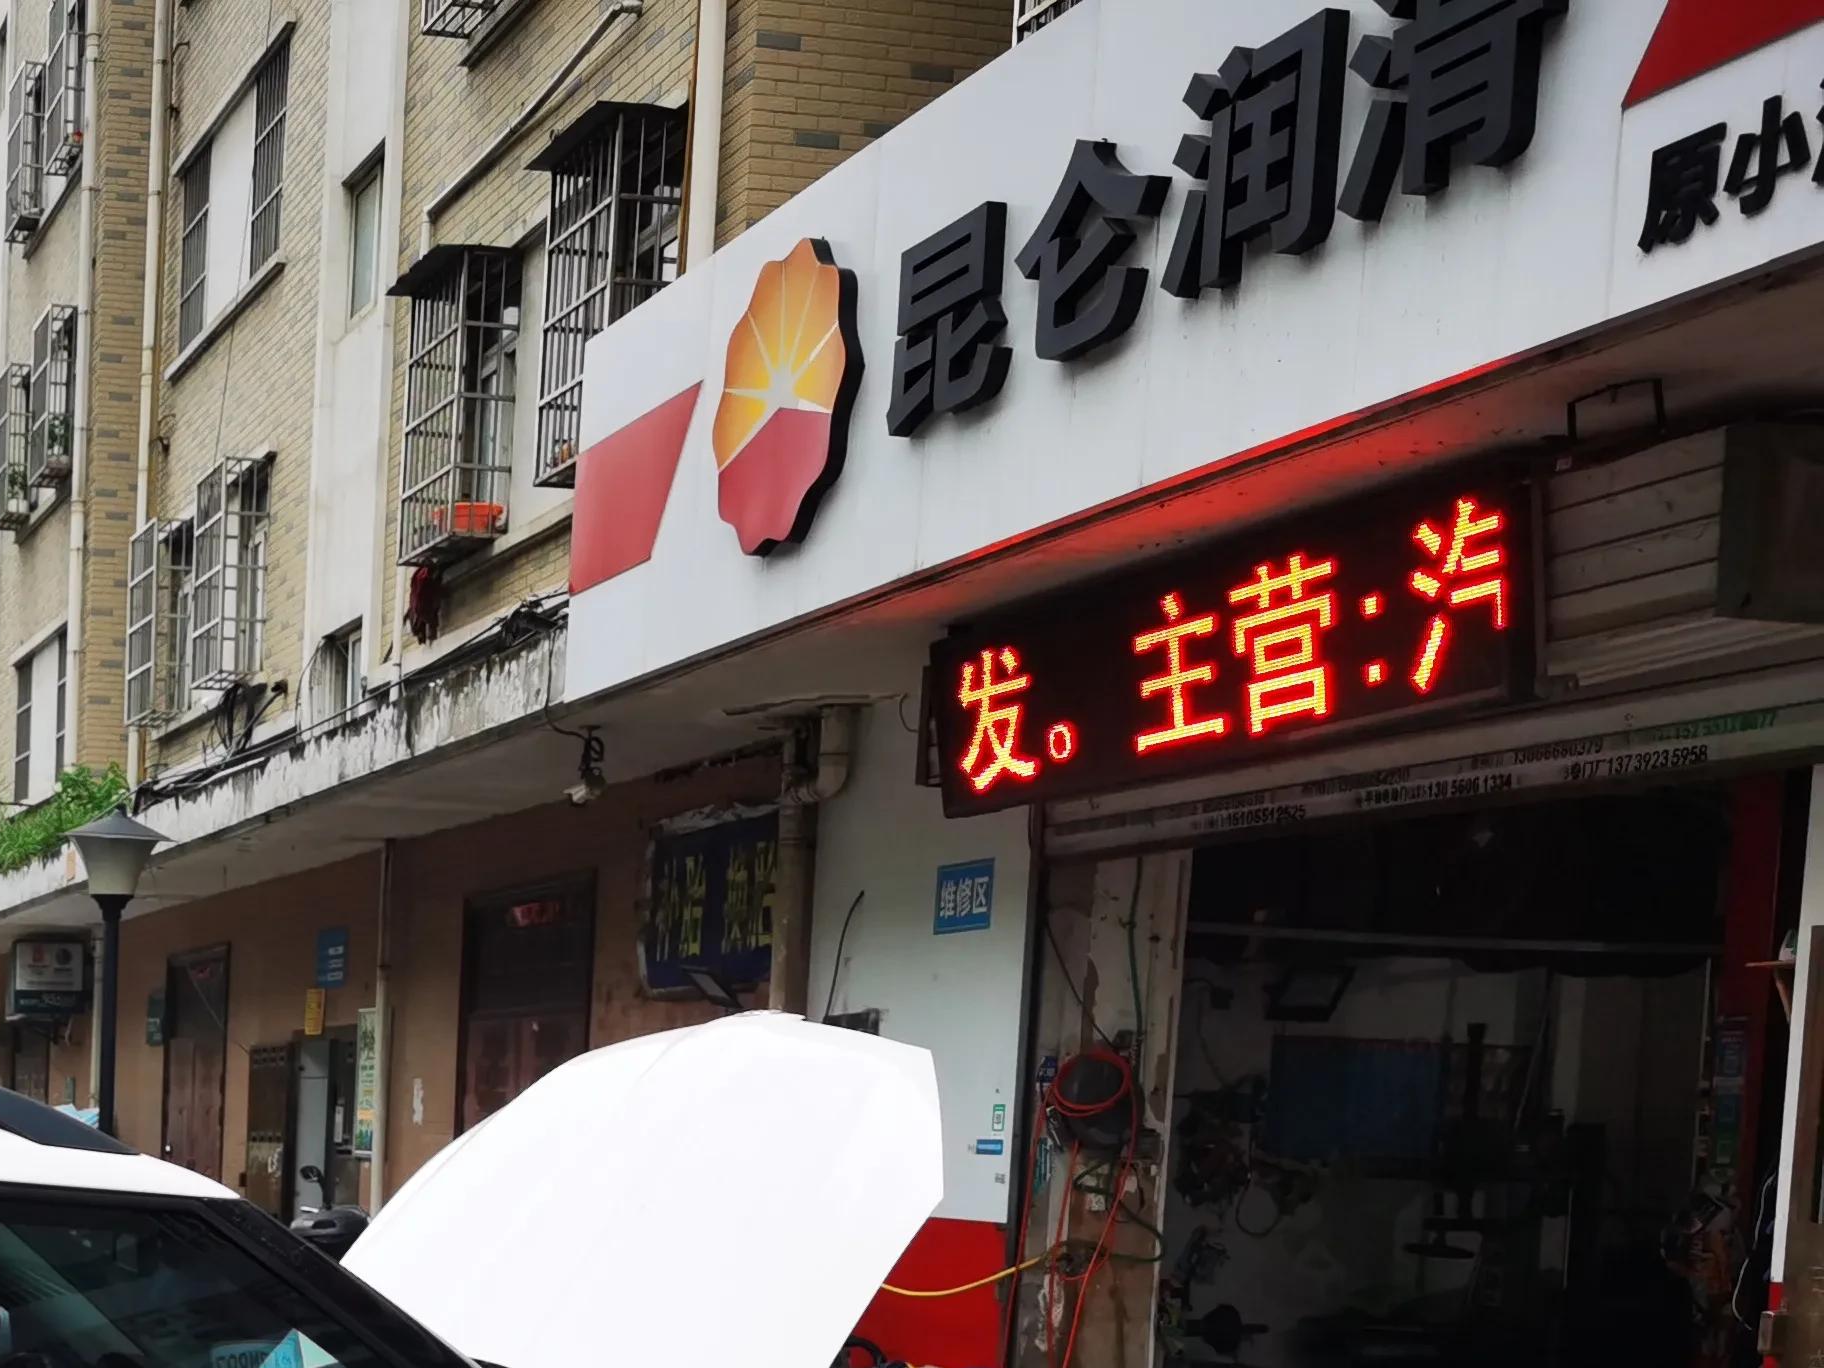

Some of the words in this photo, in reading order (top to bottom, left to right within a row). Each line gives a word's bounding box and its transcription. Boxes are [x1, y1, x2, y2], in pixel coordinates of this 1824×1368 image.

[887, 0, 1568, 437] 昆仑润滑
[1637, 79, 1824, 254] 原小
[938, 876, 989, 919] 维修区
